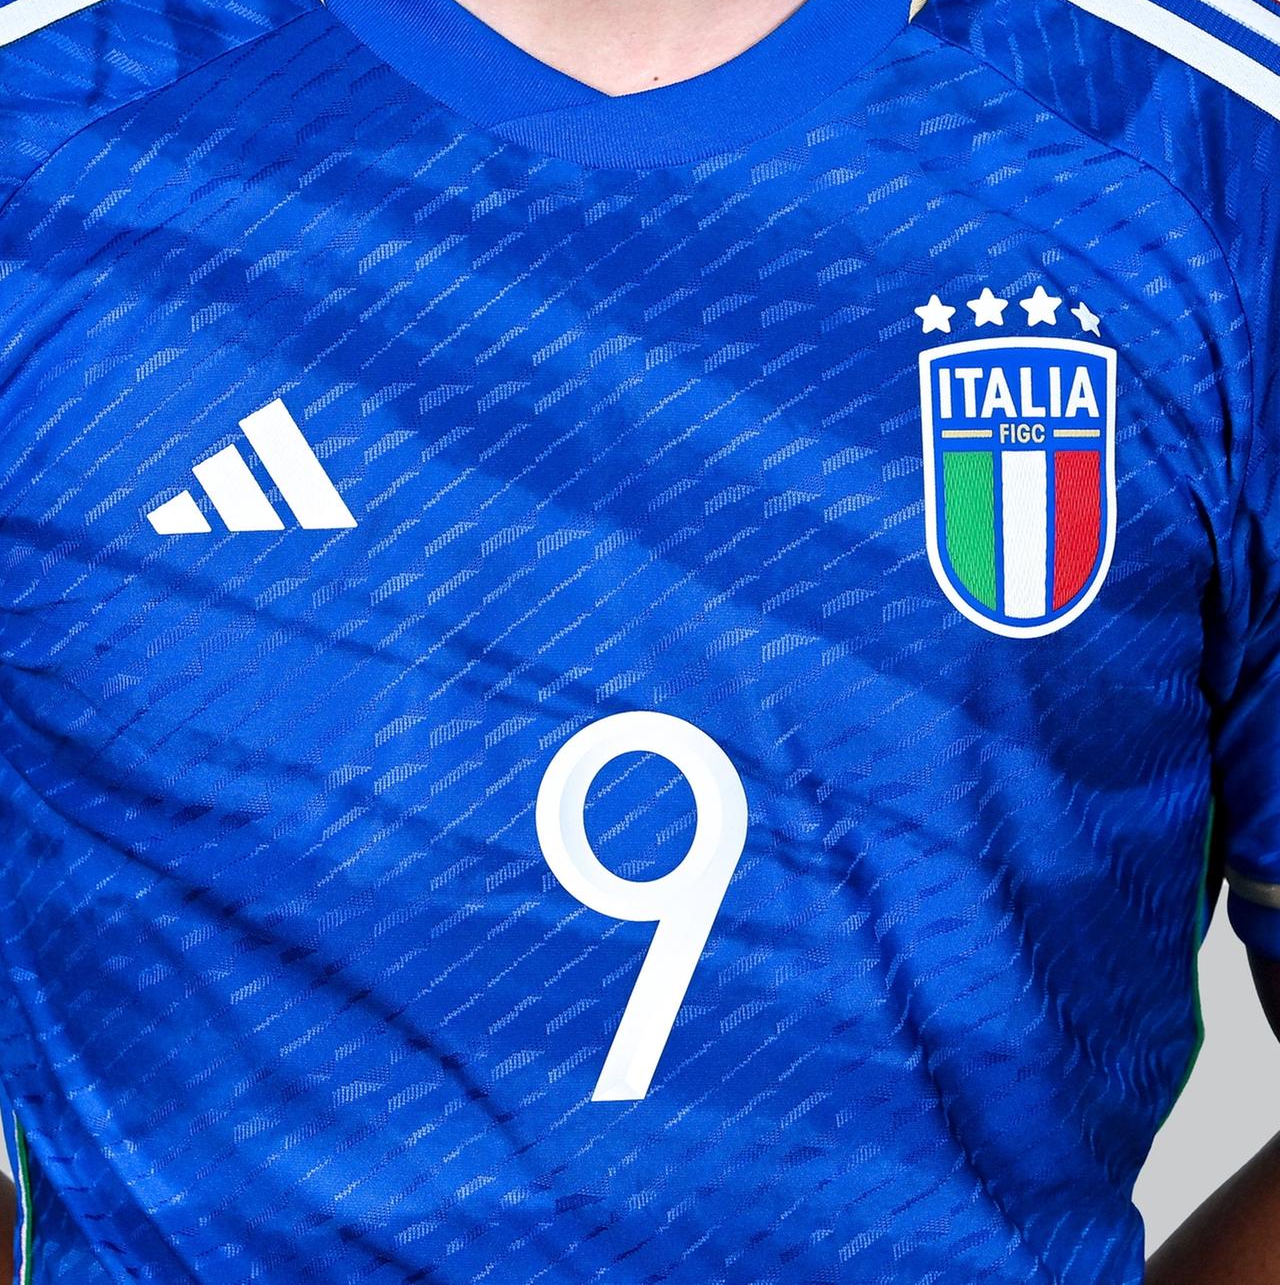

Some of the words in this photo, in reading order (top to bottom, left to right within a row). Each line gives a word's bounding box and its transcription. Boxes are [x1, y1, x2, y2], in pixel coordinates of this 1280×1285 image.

[938, 366, 1100, 419] ITALIA
[999, 423, 1046, 445] FIGC
[535, 710, 749, 1102] 9
